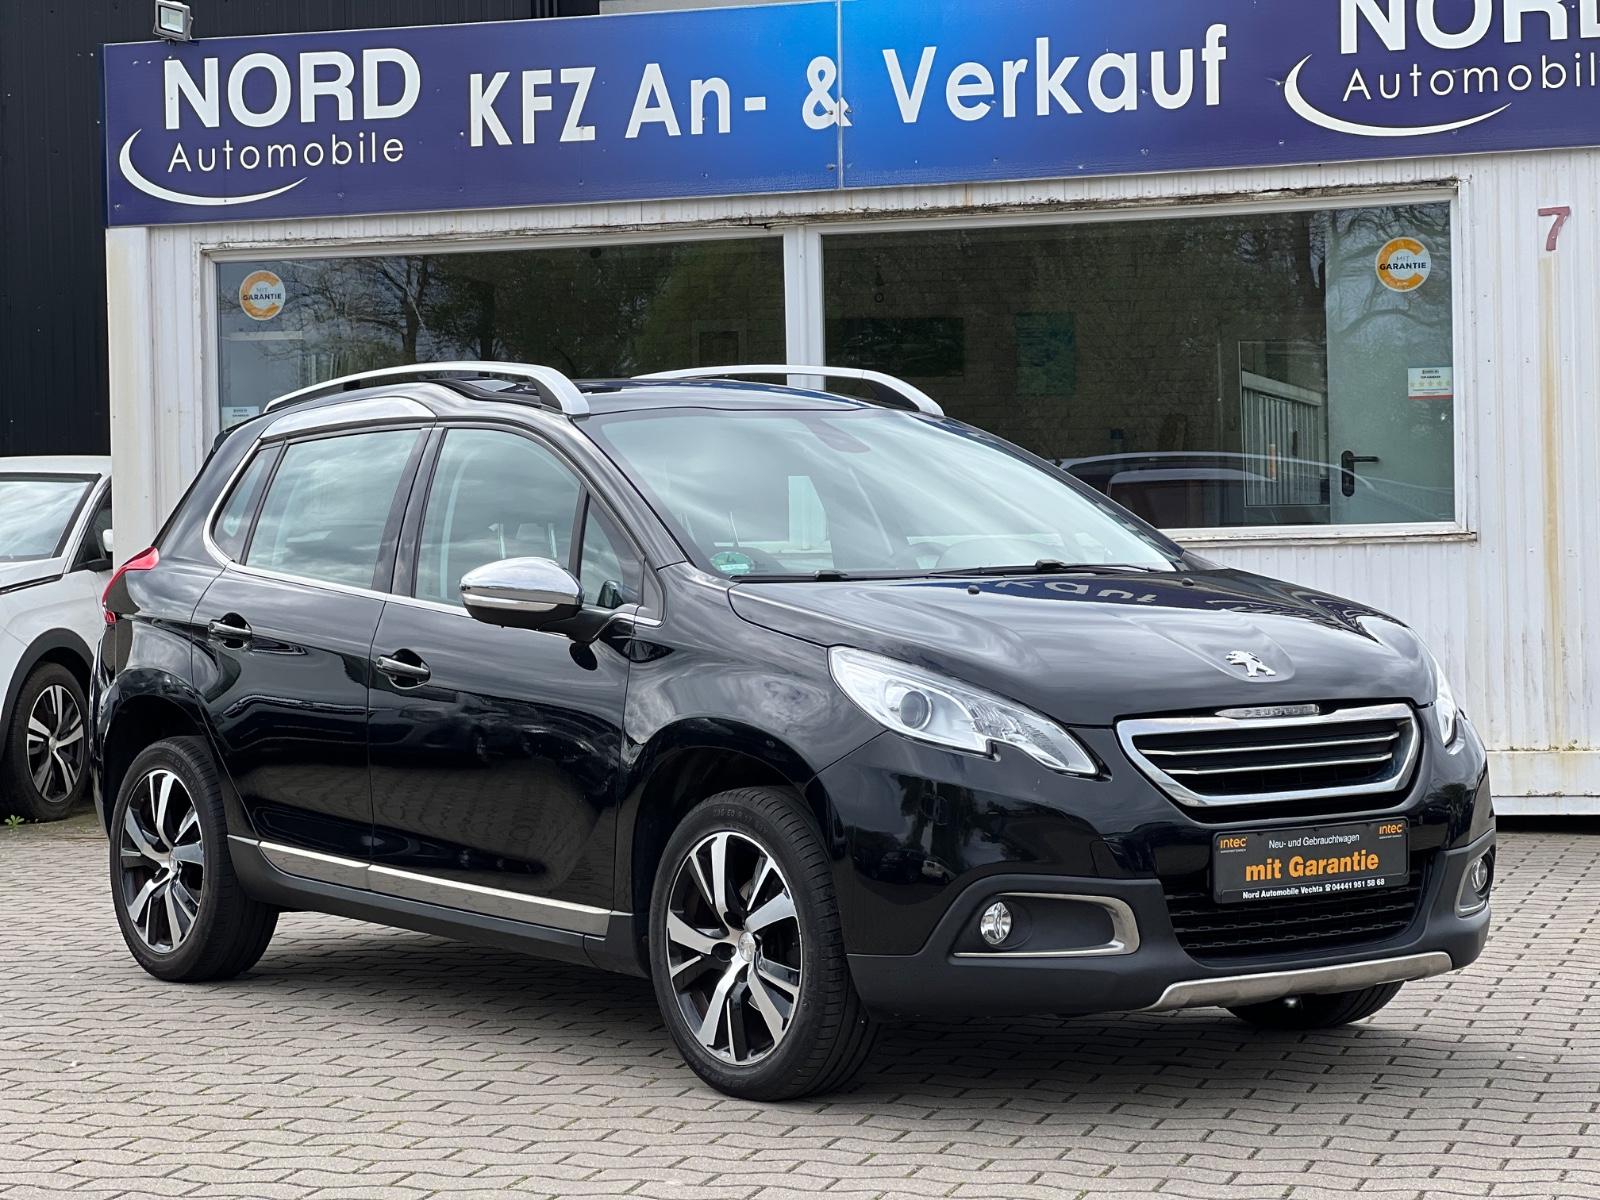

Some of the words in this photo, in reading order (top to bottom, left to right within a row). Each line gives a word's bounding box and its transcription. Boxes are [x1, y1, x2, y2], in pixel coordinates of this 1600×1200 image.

[1340, 0, 1600, 55] NOR
[164, 48, 421, 130] NORD
[469, 66, 597, 148] KFZ
[624, 62, 767, 139] An-
[801, 55, 853, 131] &
[882, 24, 1227, 123] Verkauf
[167, 131, 404, 173] Automobile
[1537, 206, 1573, 252] 7
[1379, 261, 1427, 271] GARANTIE
[242, 293, 282, 301] GARANTIE
[1268, 839, 1287, 849] Neu-
[1288, 837, 1302, 847] und
[1302, 833, 1360, 847] Gebrauchtwagen
[1378, 823, 1403, 835] intec
[1220, 836, 1247, 849] intec
[1245, 858, 1283, 881] mit
[1288, 849, 1380, 878] Garantie
[1242, 890, 1260, 900] Nord
[1261, 887, 1300, 899] Automobile
[1300, 885, 1323, 895] Vechta
